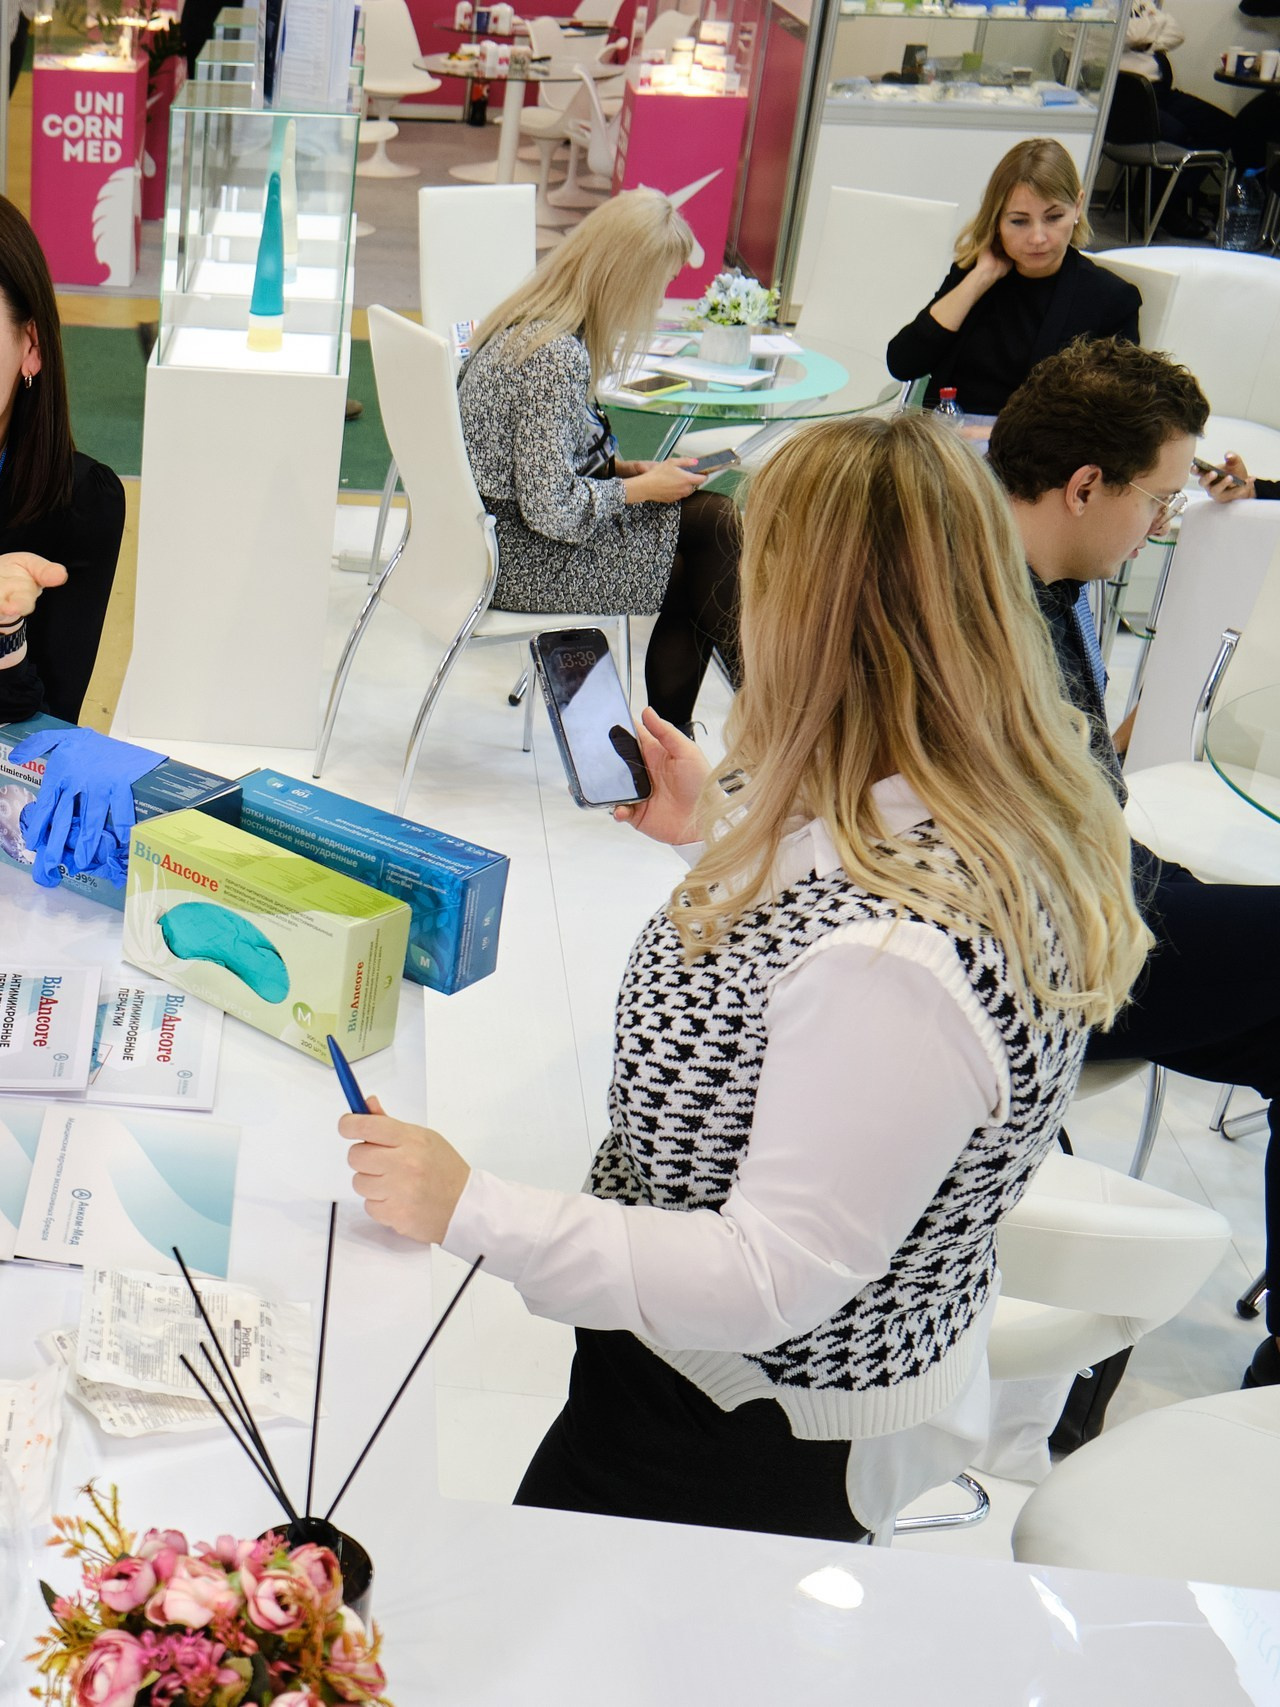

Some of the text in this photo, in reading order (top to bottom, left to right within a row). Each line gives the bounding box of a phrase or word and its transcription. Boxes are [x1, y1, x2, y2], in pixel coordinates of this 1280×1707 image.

[74, 90, 124, 115] UNI
[42, 114, 123, 139] CORN
[62, 138, 122, 163] MED
[272, 780, 283, 789] M
[290, 787, 309, 798] 100
[263, 812, 317, 842] нитриловые
[316, 832, 377, 864] медицинские
[292, 837, 359, 868] неопудренные
[133, 840, 219, 892] BioAncore
[420, 955, 431, 969] M
[32, 975, 62, 1047] BioAncore
[112, 987, 129, 1026] ПЕРЧАТКИ
[292, 1005, 316, 1026] M
[346, 960, 365, 1033] BioAncore
[122, 988, 144, 1061] АНТИМИКРОБНЫЕ
[156, 993, 185, 1062] BioAncore
[40, 1117, 75, 1241] Медицинские перчатки эксклюзивных брендов
[68, 1201, 89, 1246] Анком-Мед
